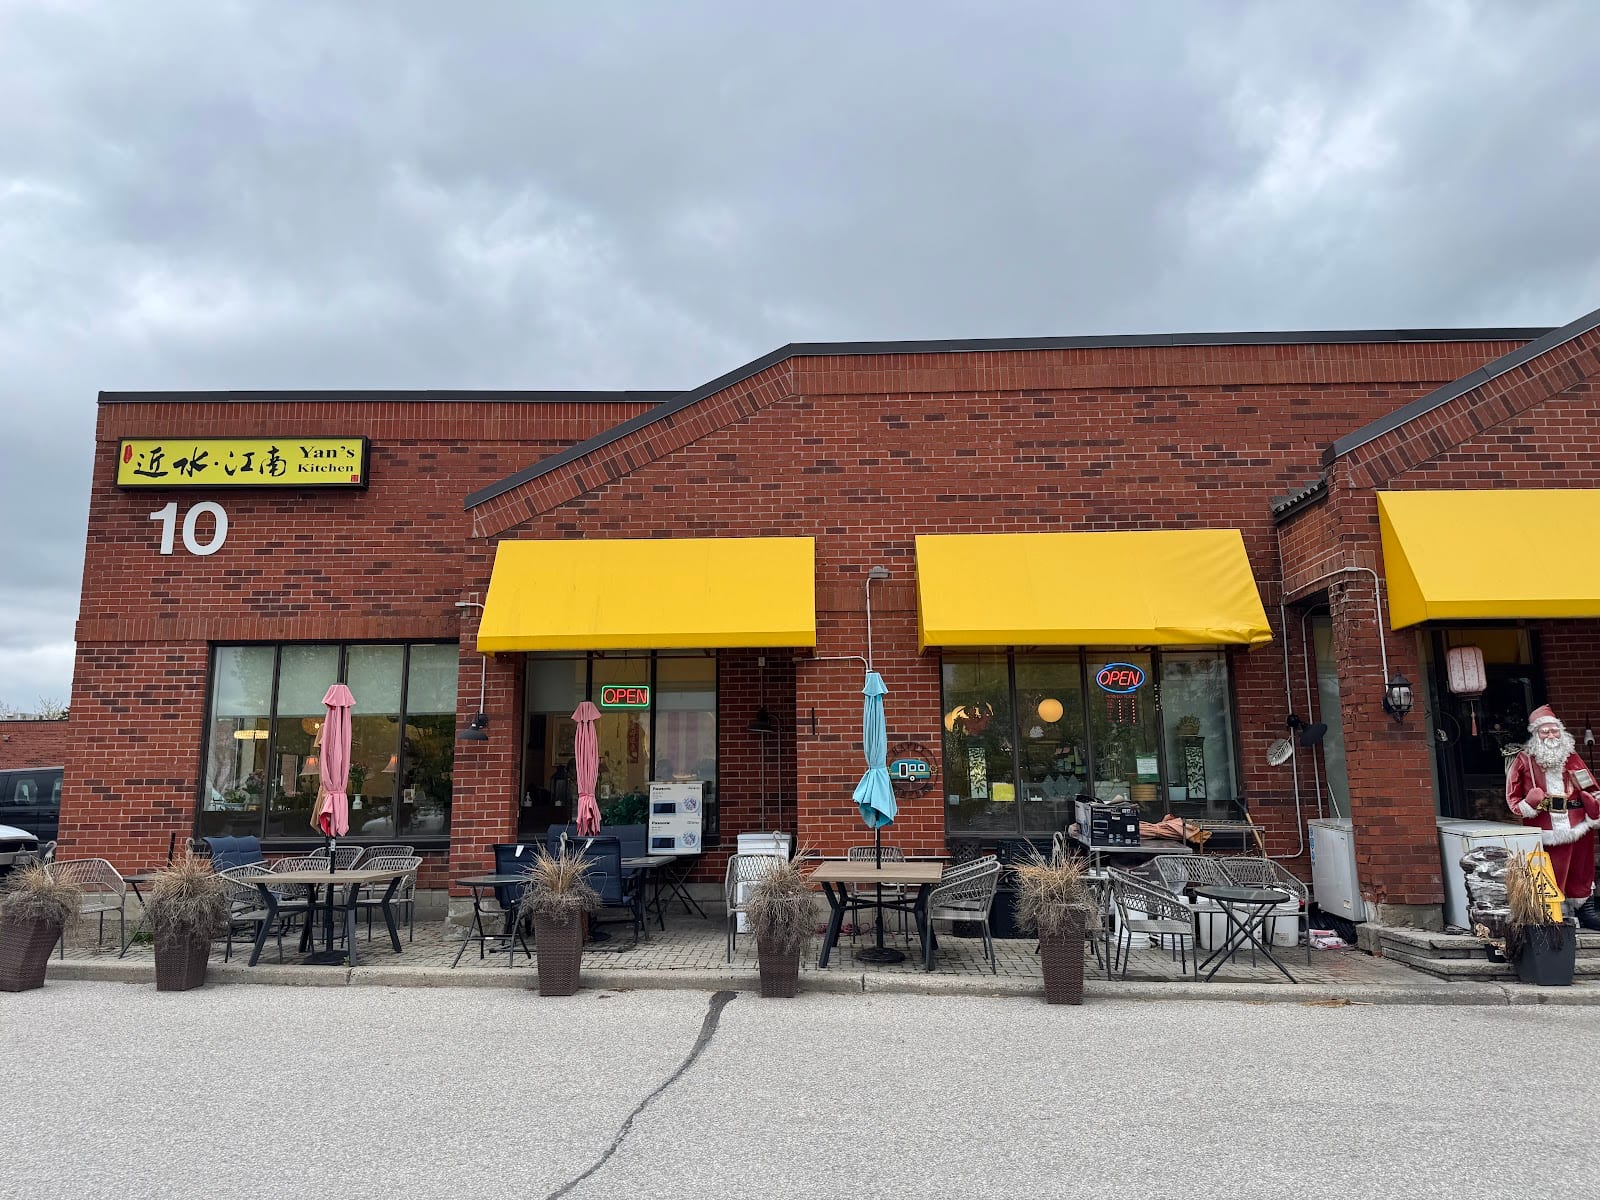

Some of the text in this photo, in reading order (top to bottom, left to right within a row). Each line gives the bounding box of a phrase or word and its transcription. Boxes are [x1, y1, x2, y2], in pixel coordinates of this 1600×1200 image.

[299, 445, 355, 458] Yan's
[298, 463, 354, 472] Kitchen
[150, 501, 228, 556] 10
[1099, 670, 1140, 686] OPEN
[603, 688, 648, 704] OPEN
